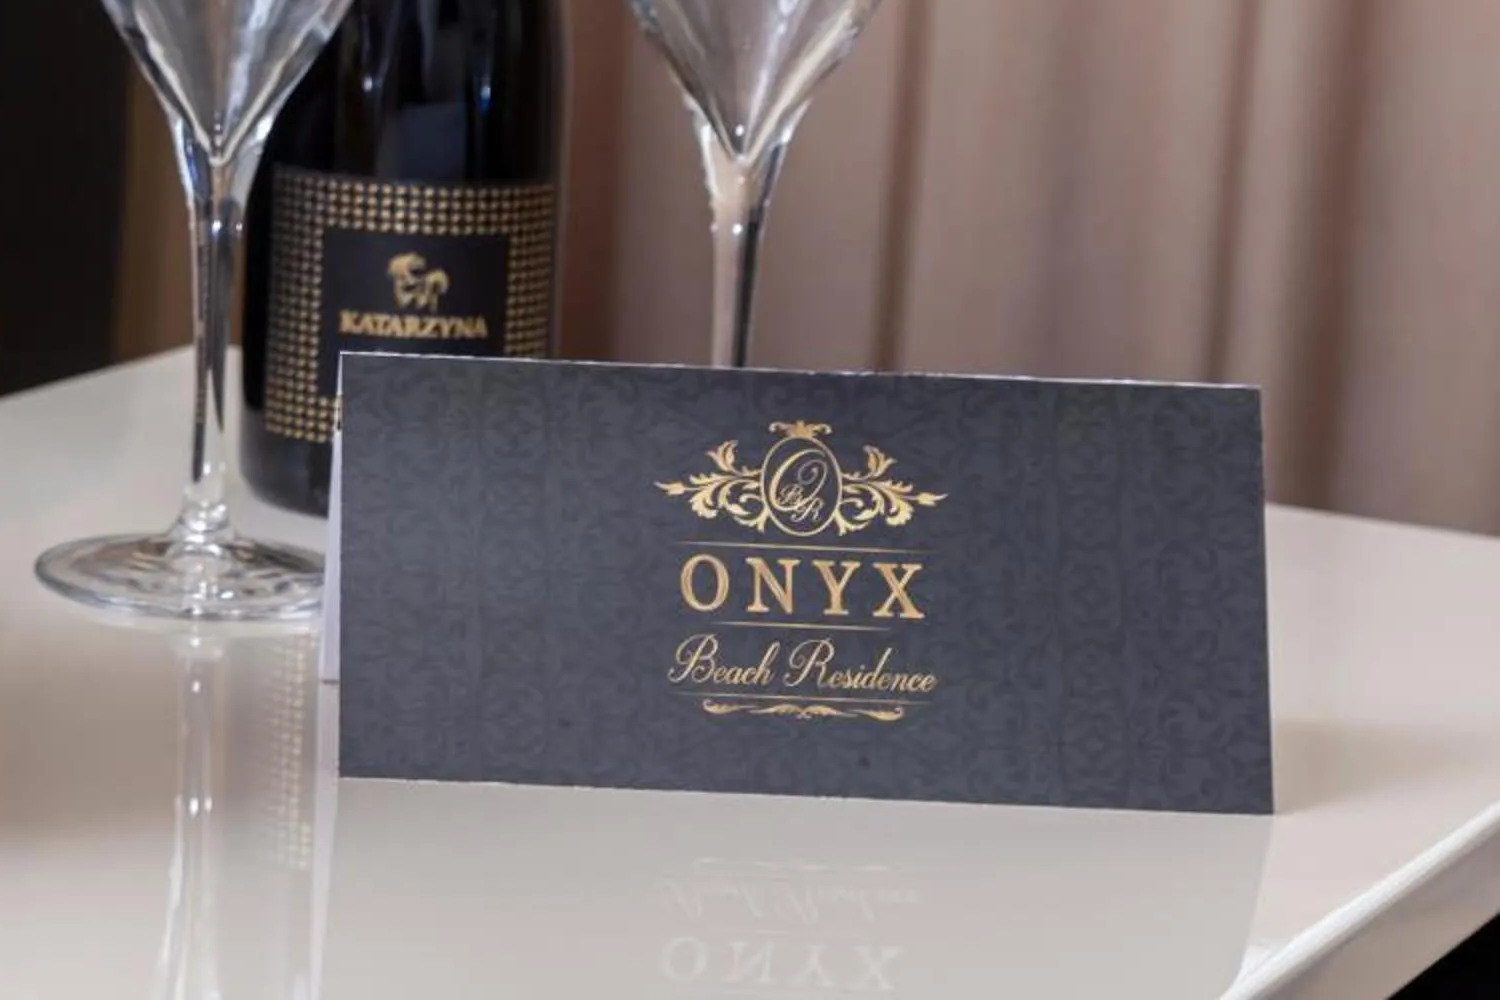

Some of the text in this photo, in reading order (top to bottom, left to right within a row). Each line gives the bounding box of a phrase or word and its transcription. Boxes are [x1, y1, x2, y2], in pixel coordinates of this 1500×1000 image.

[339, 310, 488, 339] KATARZYNA
[680, 554, 926, 619] ONYX
[667, 633, 938, 694] Beach Residence
